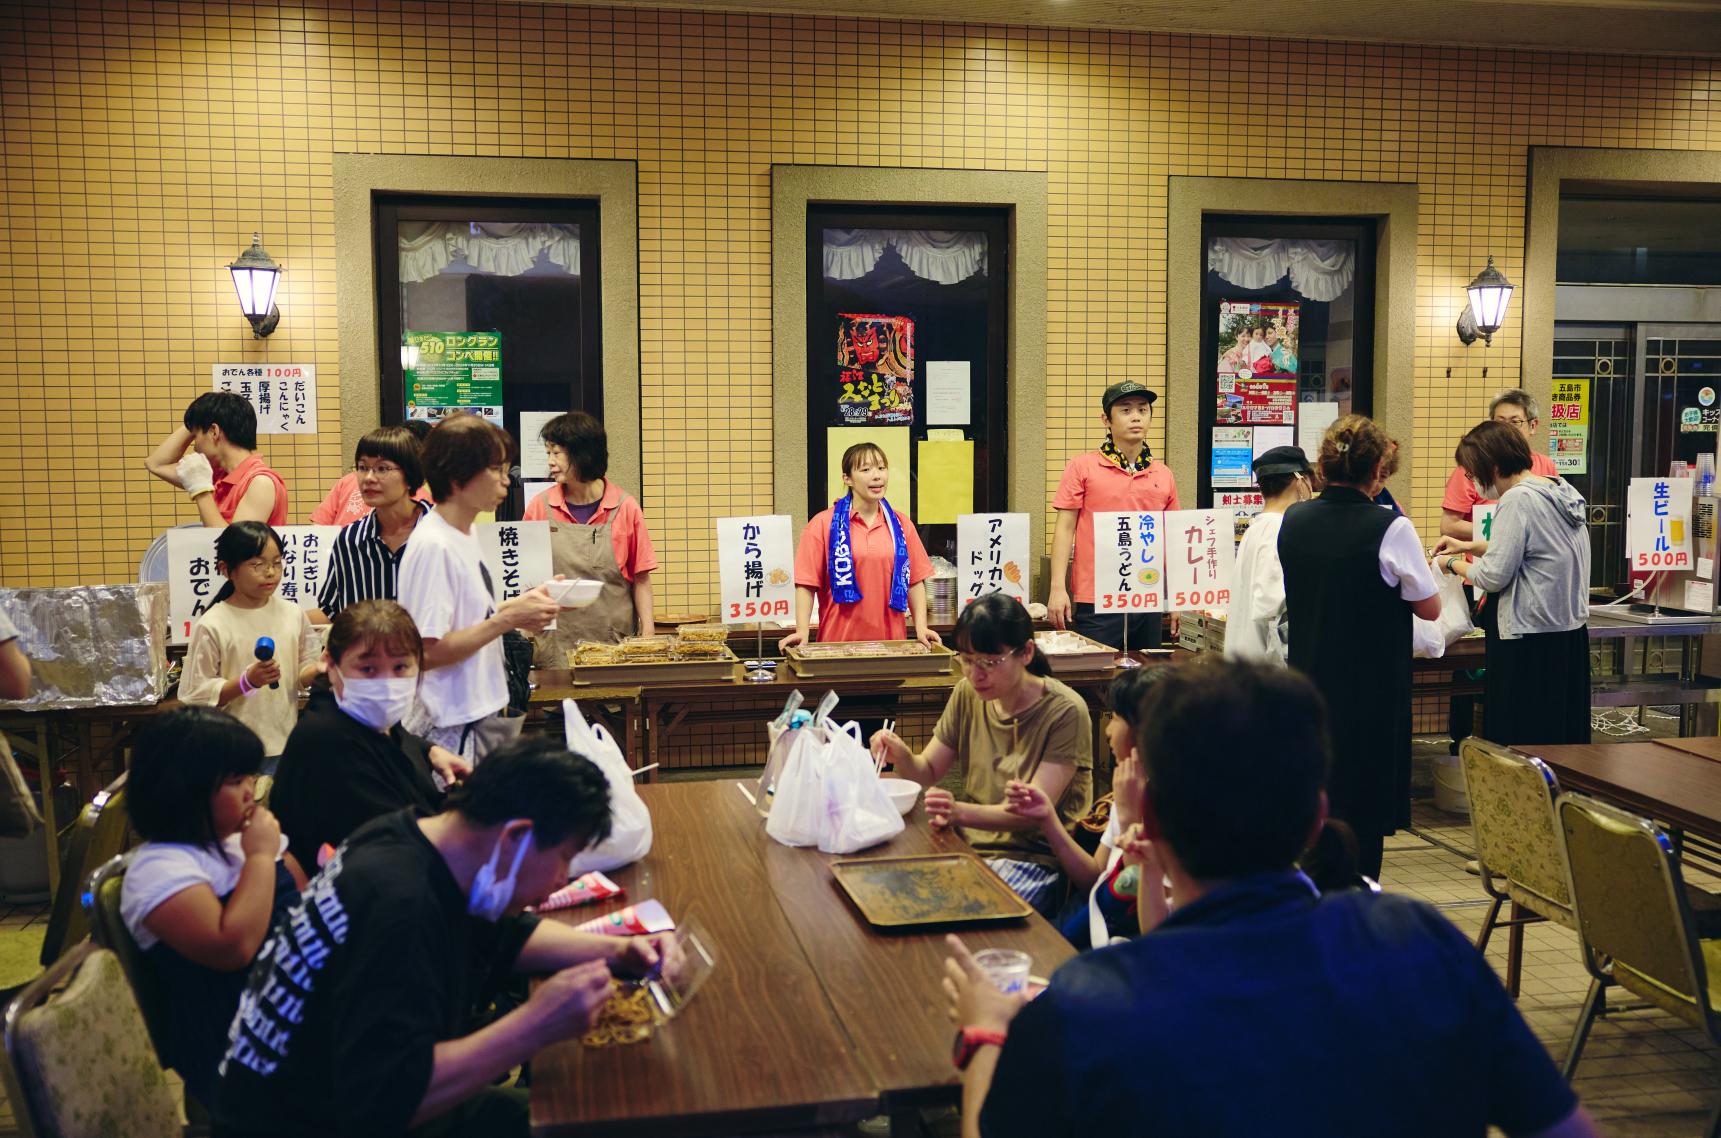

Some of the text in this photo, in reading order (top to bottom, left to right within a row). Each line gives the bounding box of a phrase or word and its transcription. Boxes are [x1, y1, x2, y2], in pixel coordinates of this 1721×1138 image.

[420, 341, 445, 354] 510
[446, 336, 498, 347] ロングラン
[267, 368, 301, 377] 100円
[1558, 384, 1582, 392] 五島市
[258, 381, 271, 415] 厚揚げ
[279, 381, 290, 432] こんにゃく
[294, 381, 306, 424] だいこん
[1138, 514, 1154, 563] 冷やし
[1654, 482, 1670, 552] 生ビール
[281, 533, 298, 604] いなり寿
[303, 533, 319, 596] おにぎり
[742, 523, 764, 598] から揚げ
[988, 518, 1003, 593] アメリカン
[1117, 516, 1132, 592] 五島うどん
[1185, 526, 1204, 584] カレー
[1206, 516, 1218, 580] シェフ手作り
[1638, 552, 1688, 566] 500円
[970, 550, 984, 596] ドッグ
[730, 600, 790, 618] 350円
[1102, 592, 1158, 608] 350円
[1175, 589, 1230, 606] 500円
